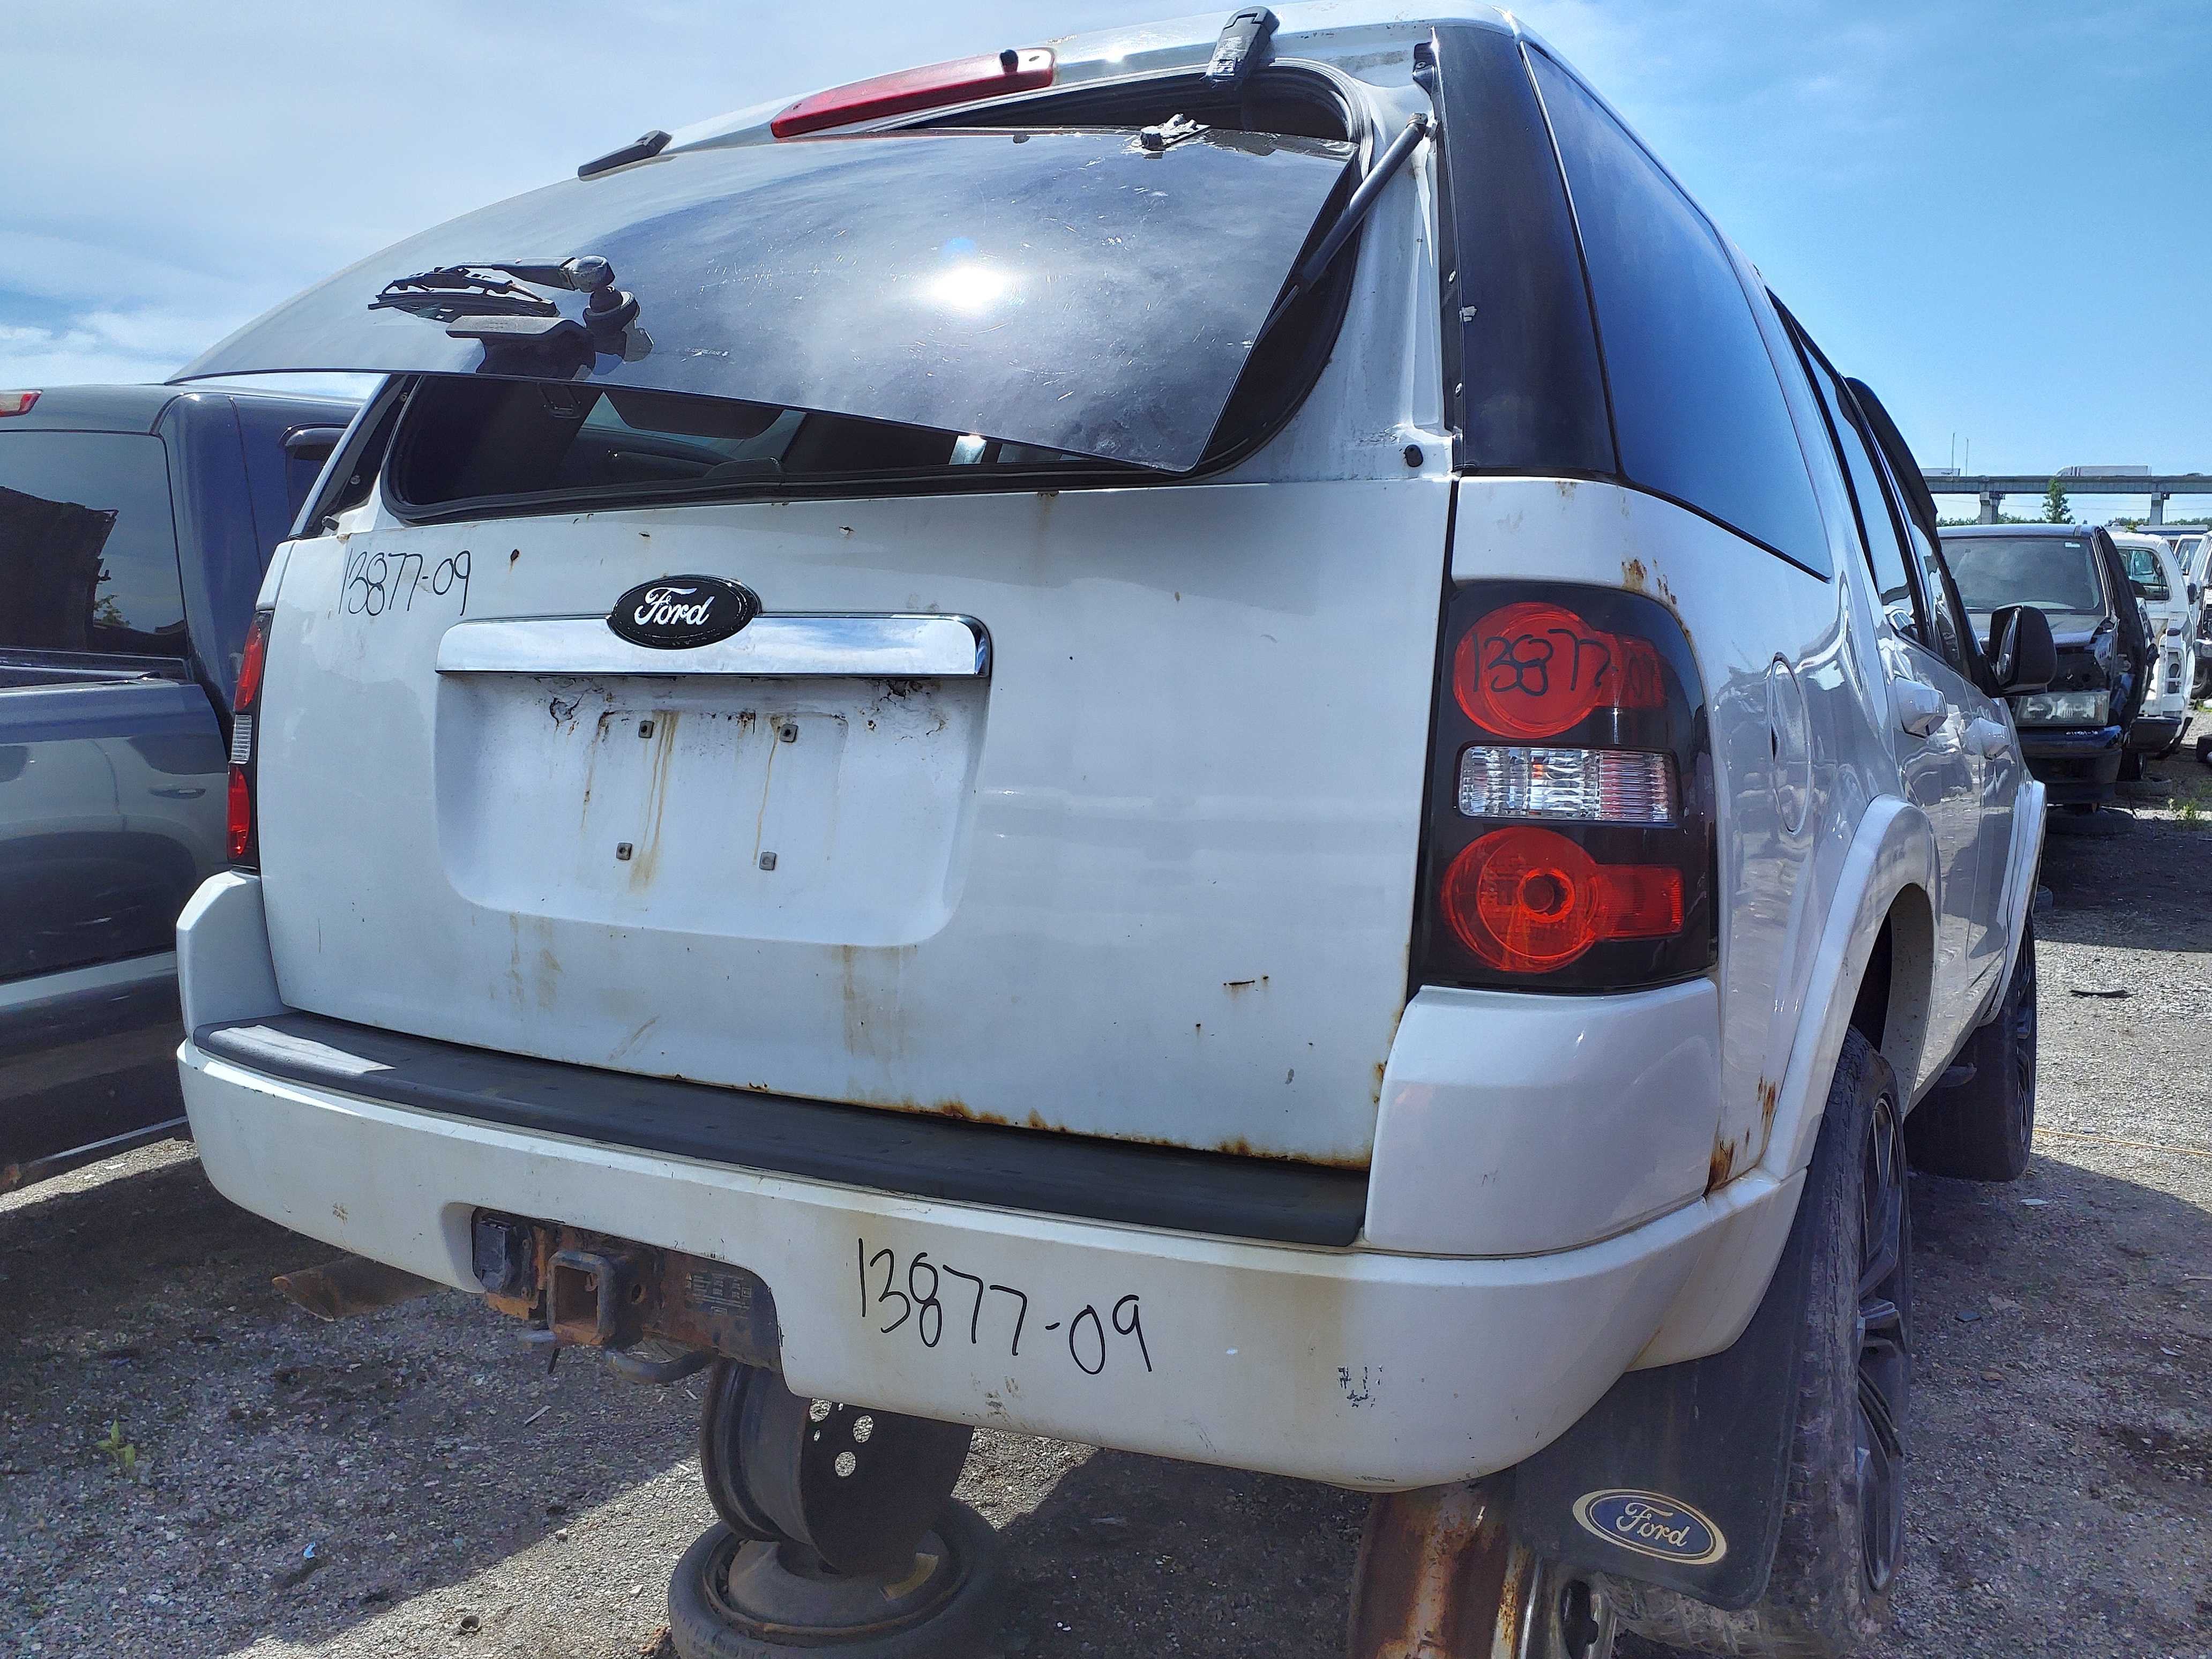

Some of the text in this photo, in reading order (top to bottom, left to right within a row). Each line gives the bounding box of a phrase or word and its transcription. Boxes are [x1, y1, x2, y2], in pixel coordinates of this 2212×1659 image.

[339, 548, 471, 616] 13877-09
[634, 586, 715, 626] Ford
[858, 1238, 1152, 1374] 13877-09
[1616, 1502, 1691, 1547] Ford
